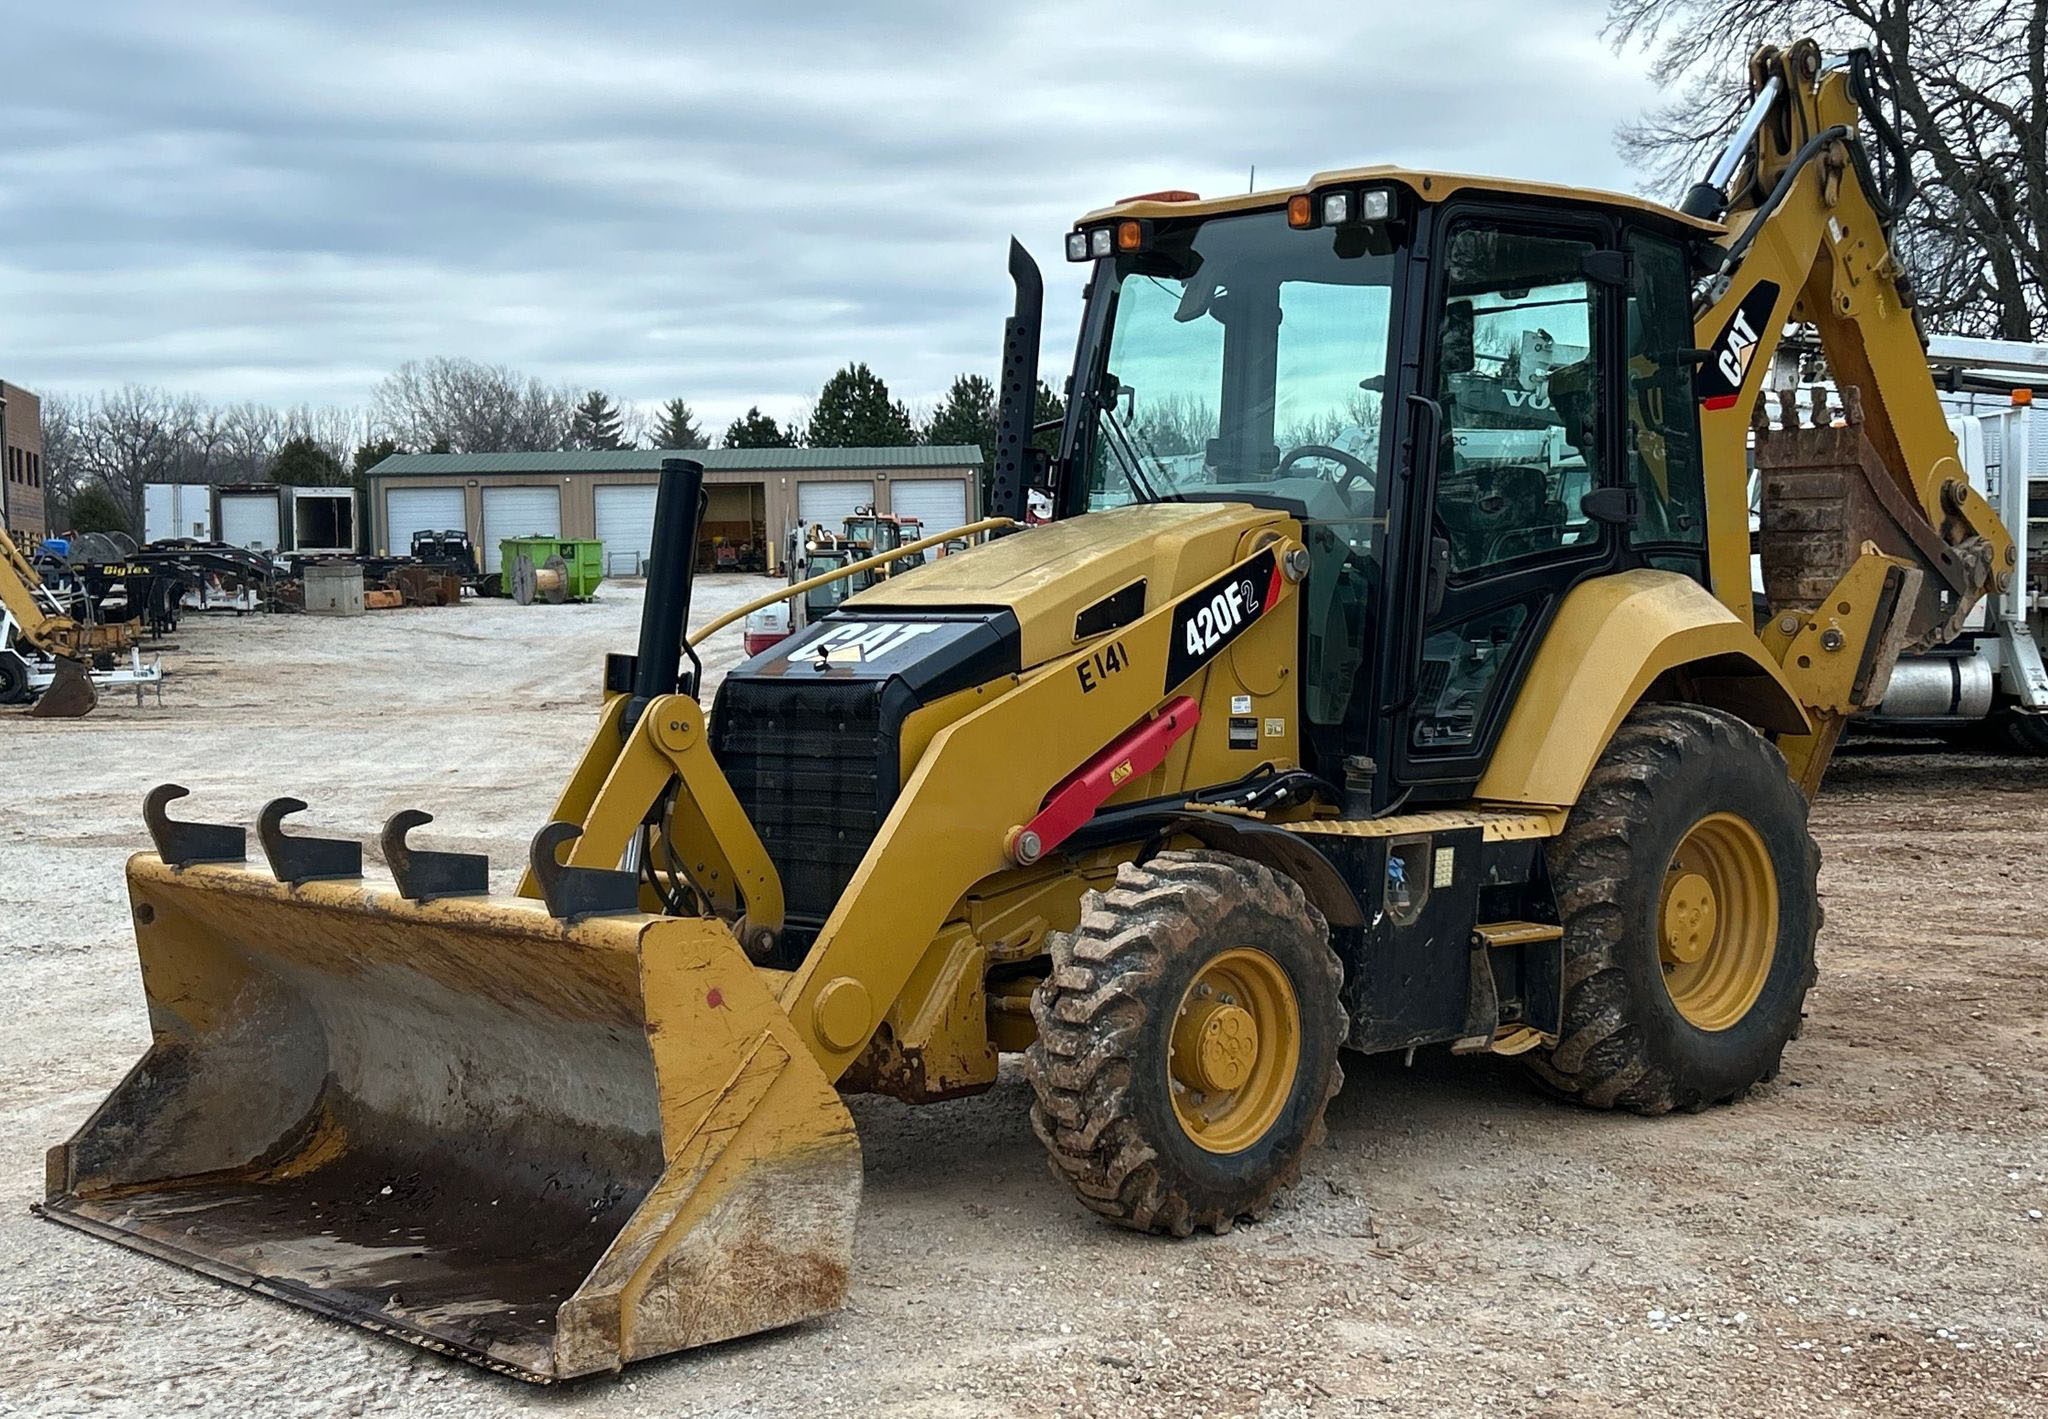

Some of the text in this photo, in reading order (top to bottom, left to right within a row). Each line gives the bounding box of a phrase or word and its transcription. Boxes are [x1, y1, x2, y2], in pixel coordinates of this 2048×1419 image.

[1719, 308, 1758, 387] CAT
[1502, 389, 1556, 410] VO
[102, 563, 151, 577] BigTex
[1186, 579, 1259, 656] 420F2
[787, 622, 943, 663] CAT
